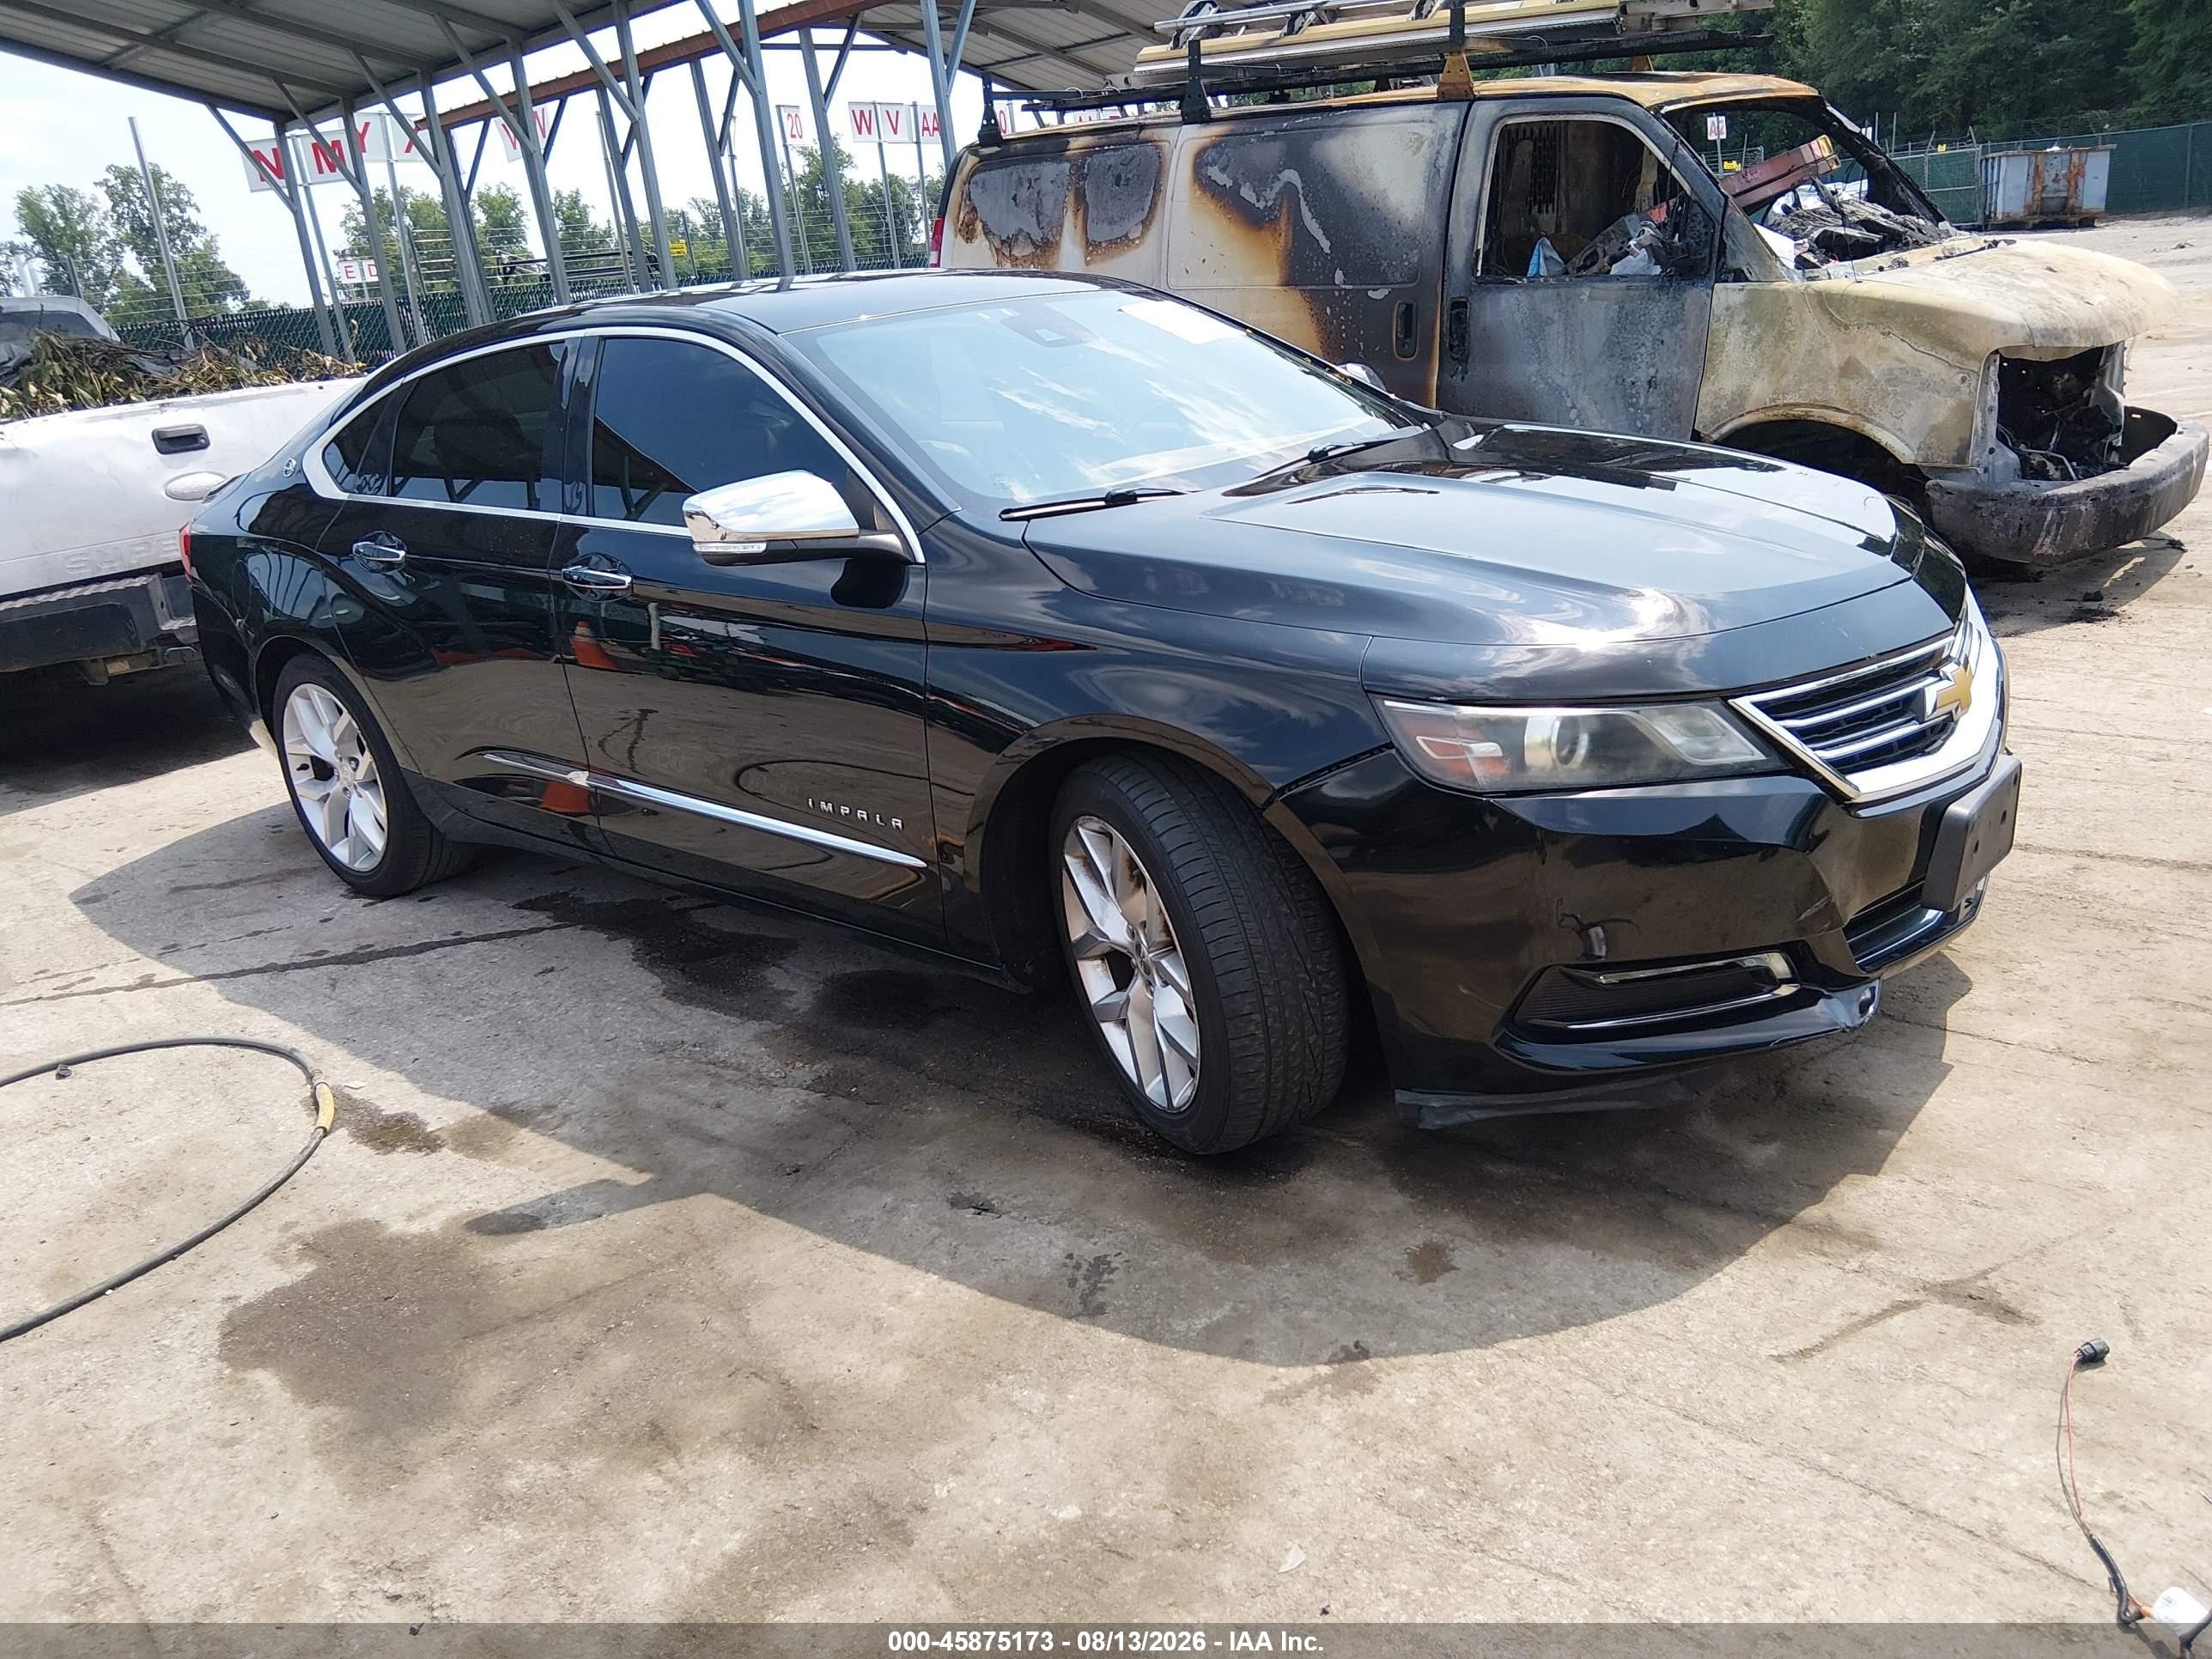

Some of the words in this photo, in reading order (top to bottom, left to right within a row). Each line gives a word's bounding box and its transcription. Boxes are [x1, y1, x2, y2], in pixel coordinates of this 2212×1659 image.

[787, 112, 803, 139] 20
[851, 109, 872, 136] W
[885, 109, 900, 136] V
[921, 111, 942, 137] AA
[252, 148, 286, 182] N
[311, 139, 347, 175] M
[343, 264, 356, 279] E
[808, 797, 904, 831] IMPALA
